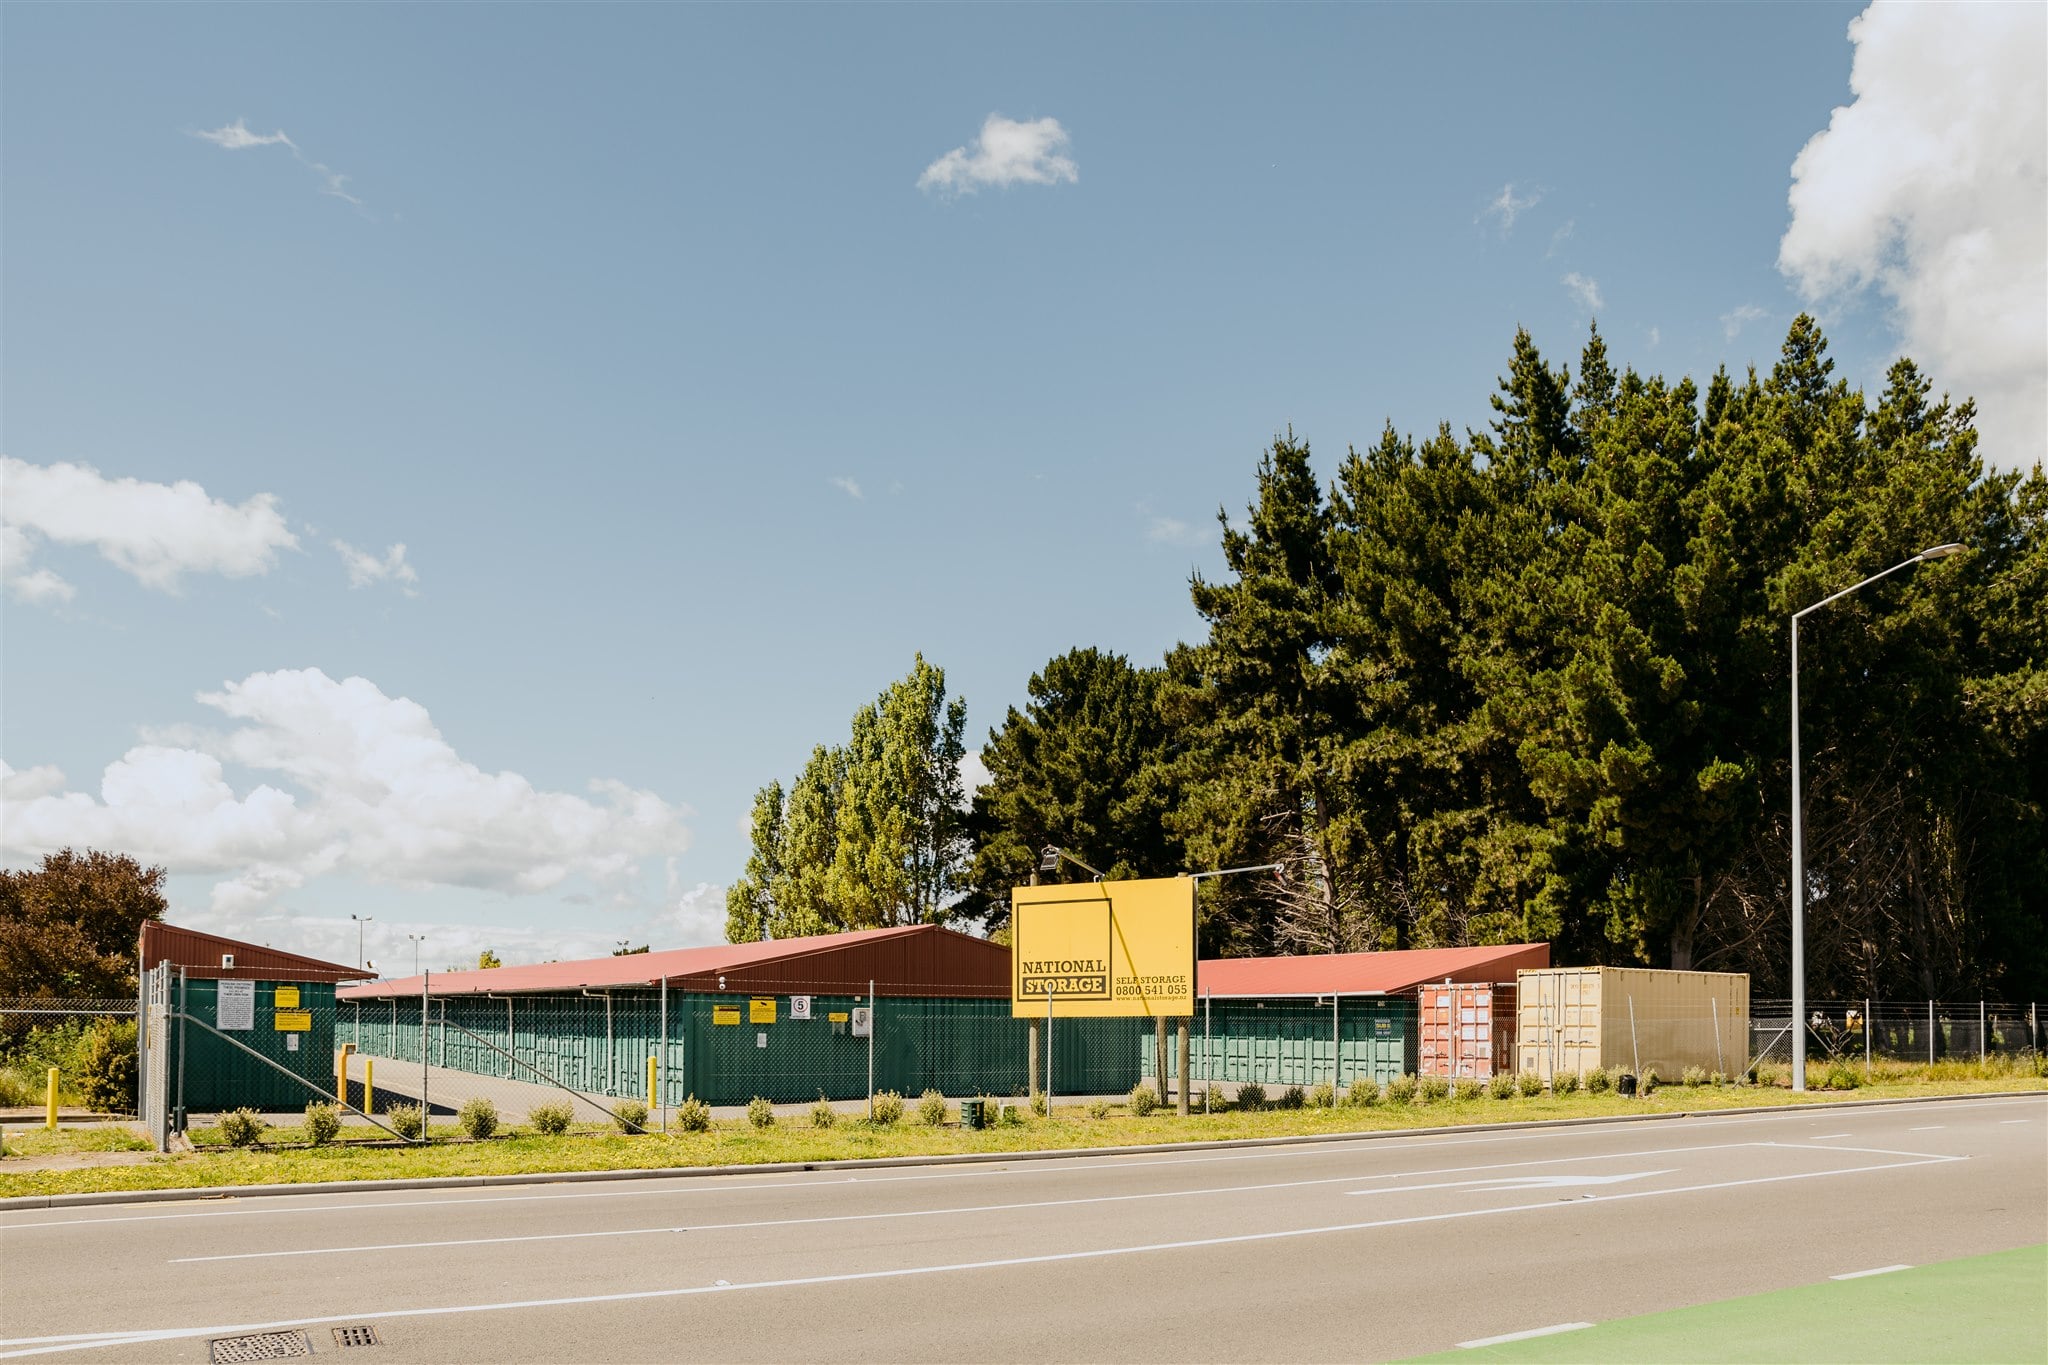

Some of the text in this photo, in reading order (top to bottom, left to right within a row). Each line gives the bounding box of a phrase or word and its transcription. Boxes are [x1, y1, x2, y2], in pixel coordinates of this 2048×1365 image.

[1022, 959, 1106, 974] NATIONAL
[1026, 978, 1102, 992] STORAGE
[1140, 976, 1186, 984] STORAGE
[1116, 985, 1187, 995] 0800 541 055
[798, 1001, 804, 1010] 5
